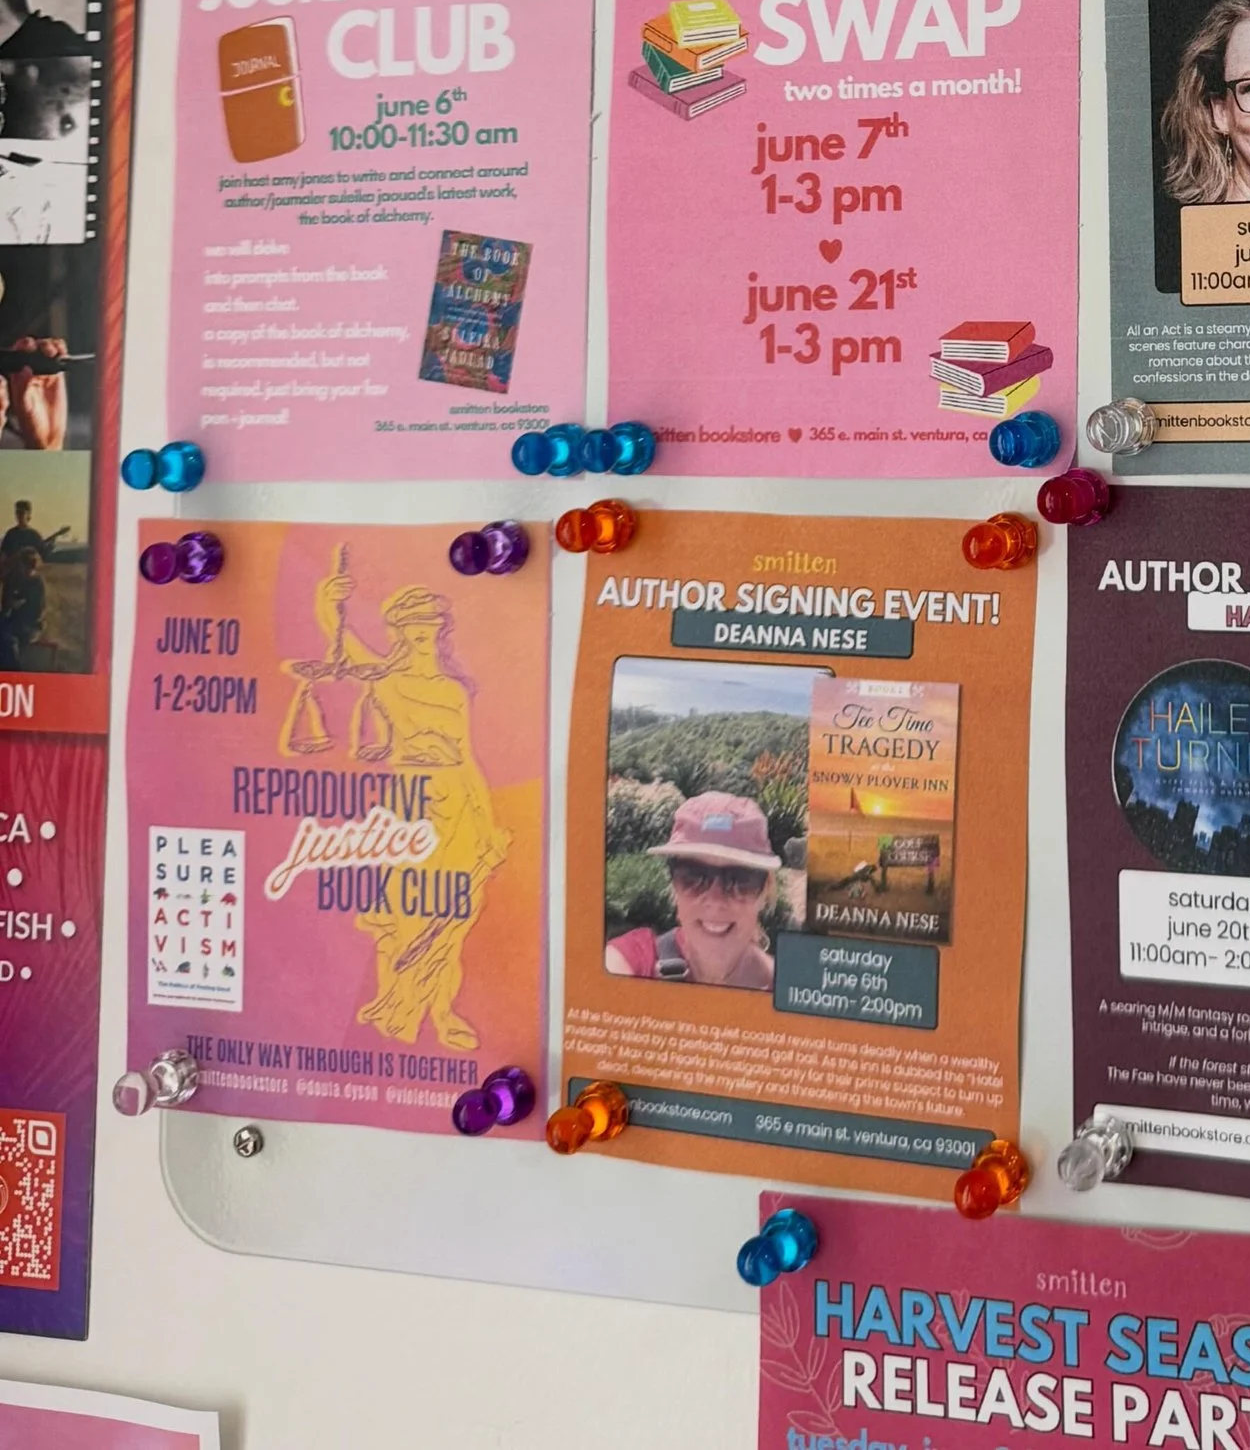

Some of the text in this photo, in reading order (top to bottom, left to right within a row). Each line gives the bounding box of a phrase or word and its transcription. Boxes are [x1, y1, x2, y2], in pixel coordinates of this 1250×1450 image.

[328, 4, 516, 79] CLUB
[375, 88, 468, 124] june 6th
[784, 70, 1022, 103] two times a month!
[330, 122, 518, 150] 10:00-11:30 am
[156, 616, 239, 656] JUNE 10
[714, 622, 869, 651] DEANNA NESE
[153, 674, 258, 715] 1-2:30PM
[822, 733, 942, 761] TRAGEDY
[232, 766, 432, 821] REPRODUCTIVE
[318, 865, 472, 918] BOOK CLUB
[814, 1278, 1089, 1367] HARVEST
[842, 1349, 1095, 1440] RELEASE
